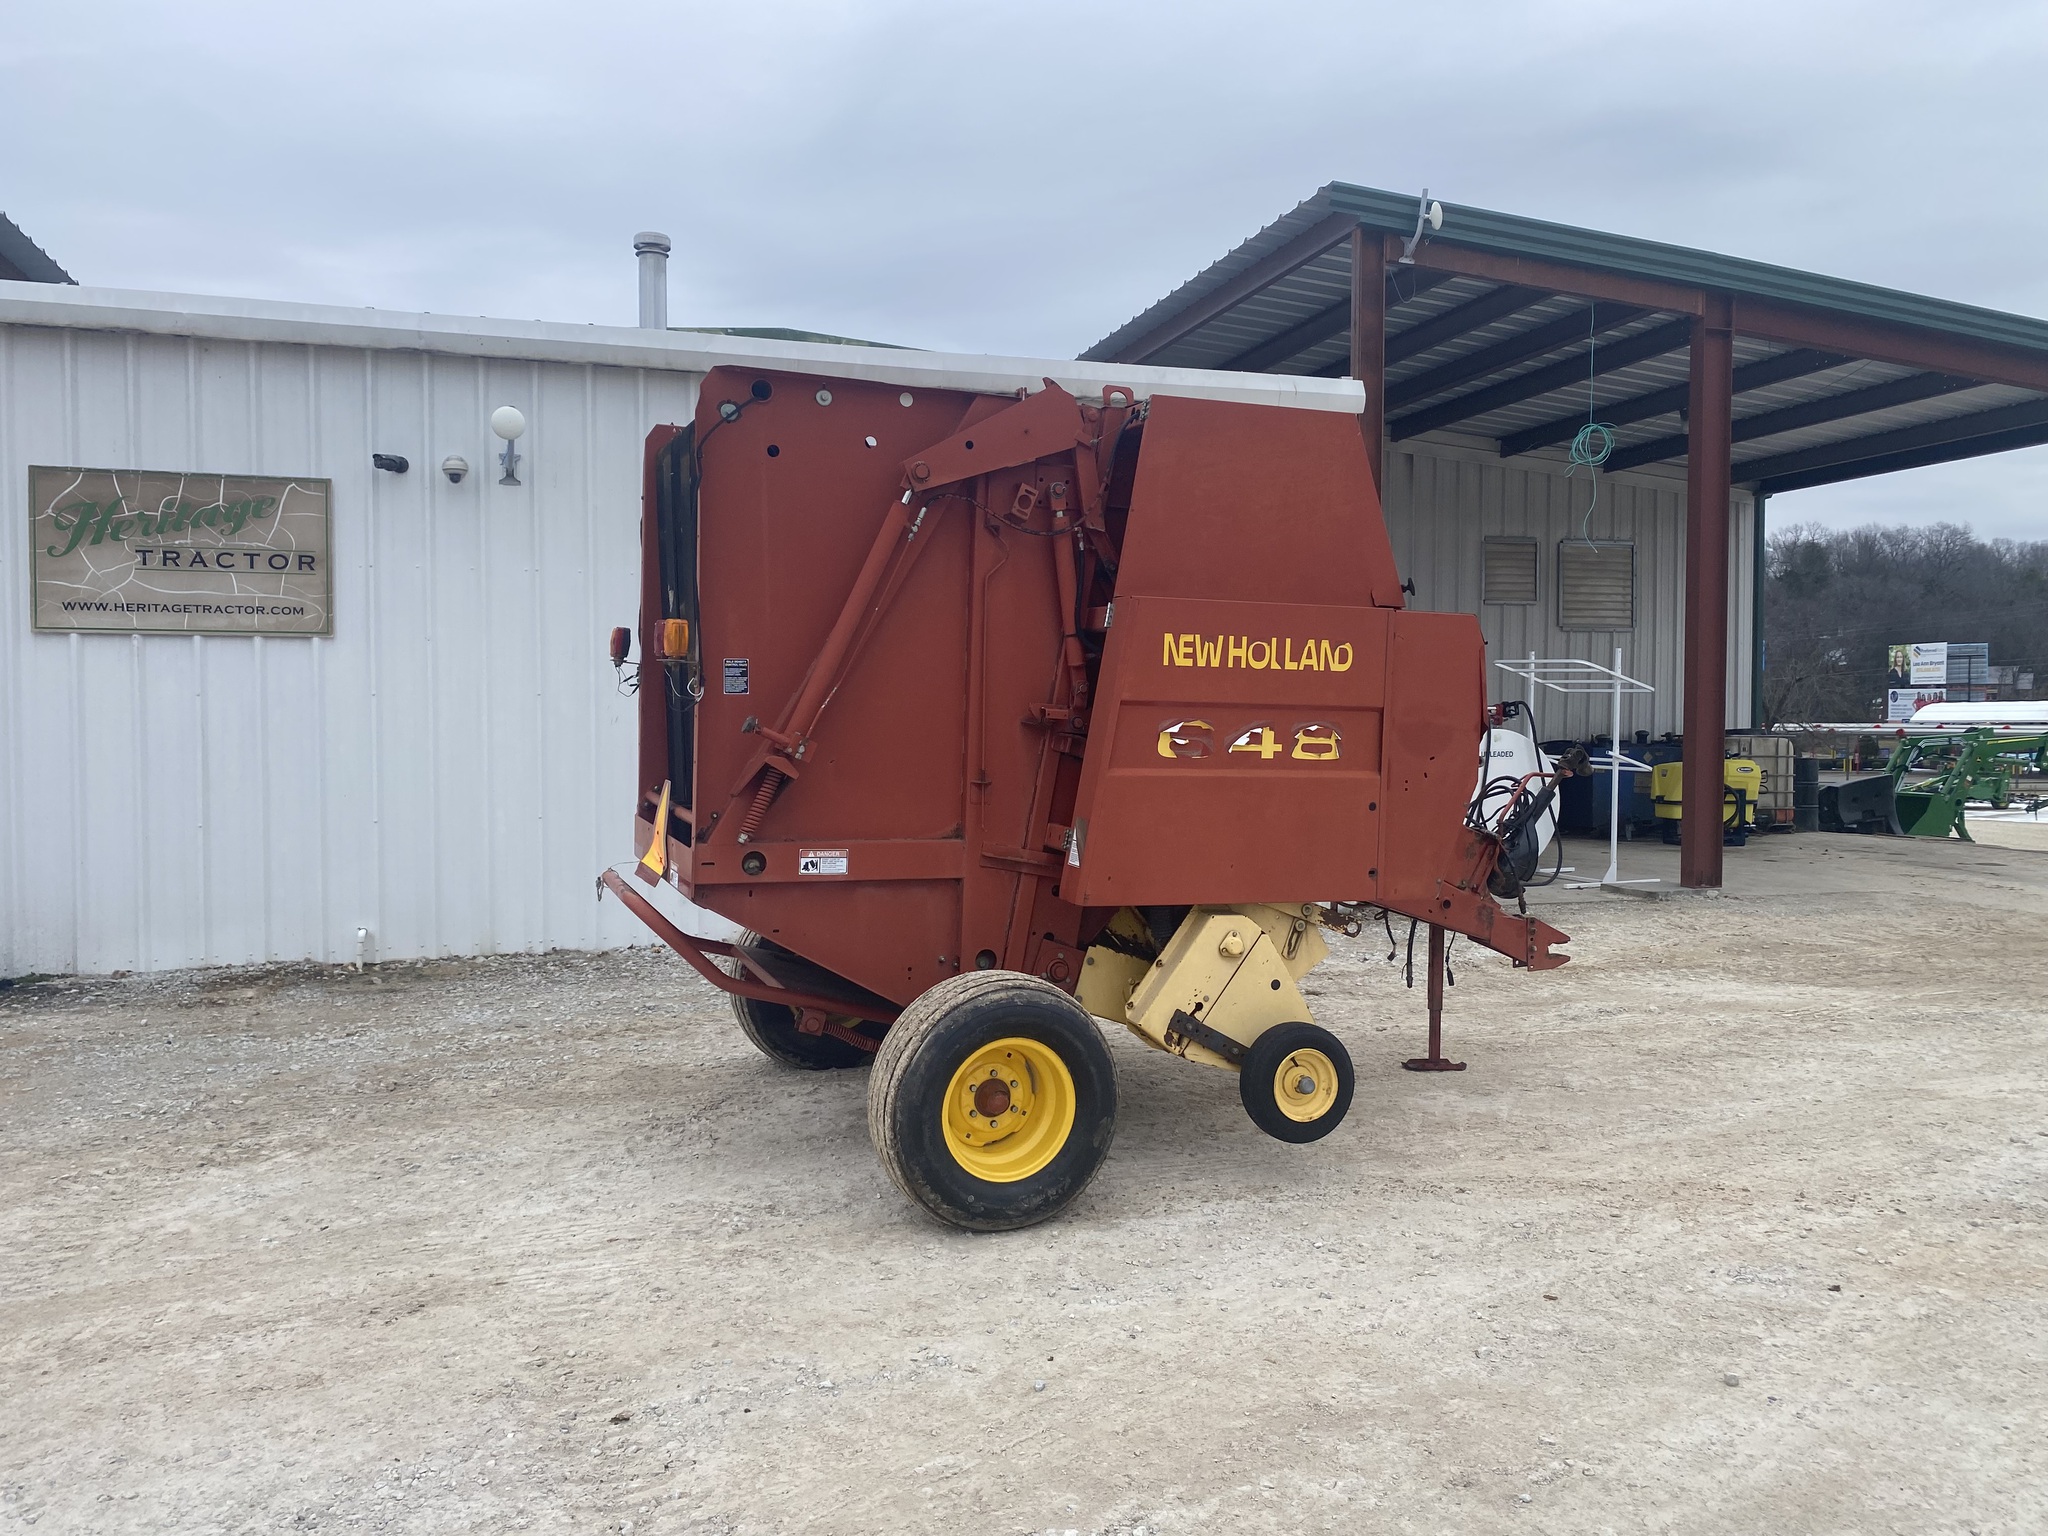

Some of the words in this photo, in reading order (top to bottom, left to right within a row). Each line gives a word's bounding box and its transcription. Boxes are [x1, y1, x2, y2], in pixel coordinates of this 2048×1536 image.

[47, 496, 280, 557] Heritage
[135, 549, 316, 571] TRACTOR
[62, 601, 304, 616] WWW.HERITAGETRACTOR.COM
[1157, 719, 1342, 760] 648
